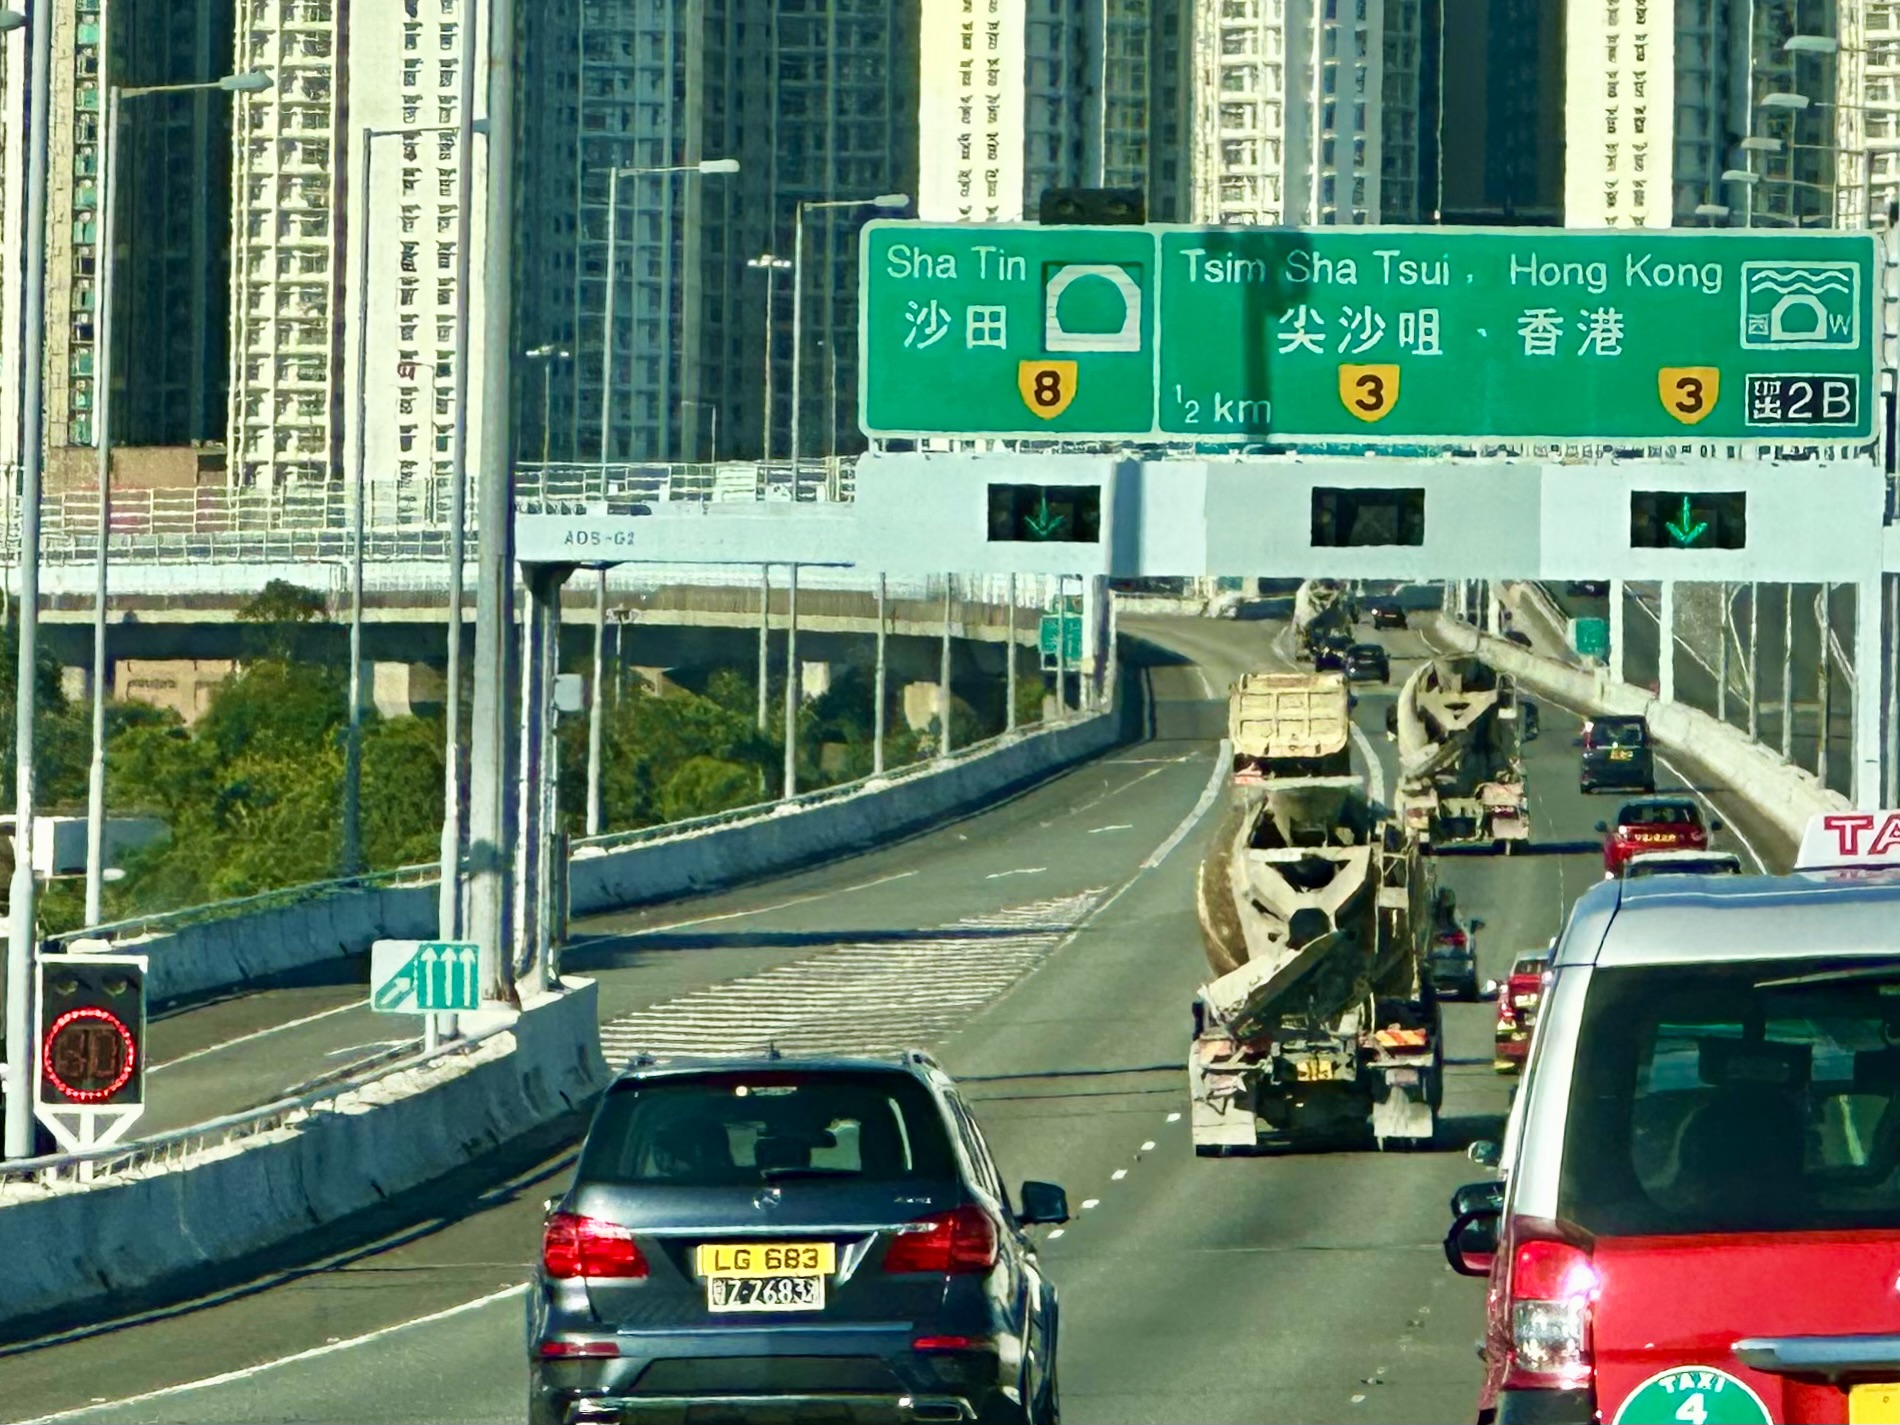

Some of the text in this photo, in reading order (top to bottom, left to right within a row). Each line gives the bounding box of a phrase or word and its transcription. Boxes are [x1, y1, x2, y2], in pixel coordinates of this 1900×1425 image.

[887, 244, 1026, 281] Sha Tin
[1181, 248, 1266, 283] Tsim
[1286, 250, 1358, 285] Sha
[1510, 252, 1607, 294] Hong
[1626, 253, 1723, 294] Kong
[903, 299, 1008, 349] 沙田
[1829, 313, 1850, 336] W
[1034, 370, 1061, 406] 8
[1355, 374, 1384, 411] 3
[1675, 377, 1704, 414] 3
[1787, 381, 1851, 419] 2B
[1214, 393, 1271, 424] km
[715, 1248, 818, 1271] LG 683
[1659, 1372, 1726, 1393] TAXI
[1675, 1392, 1708, 1425] 4
